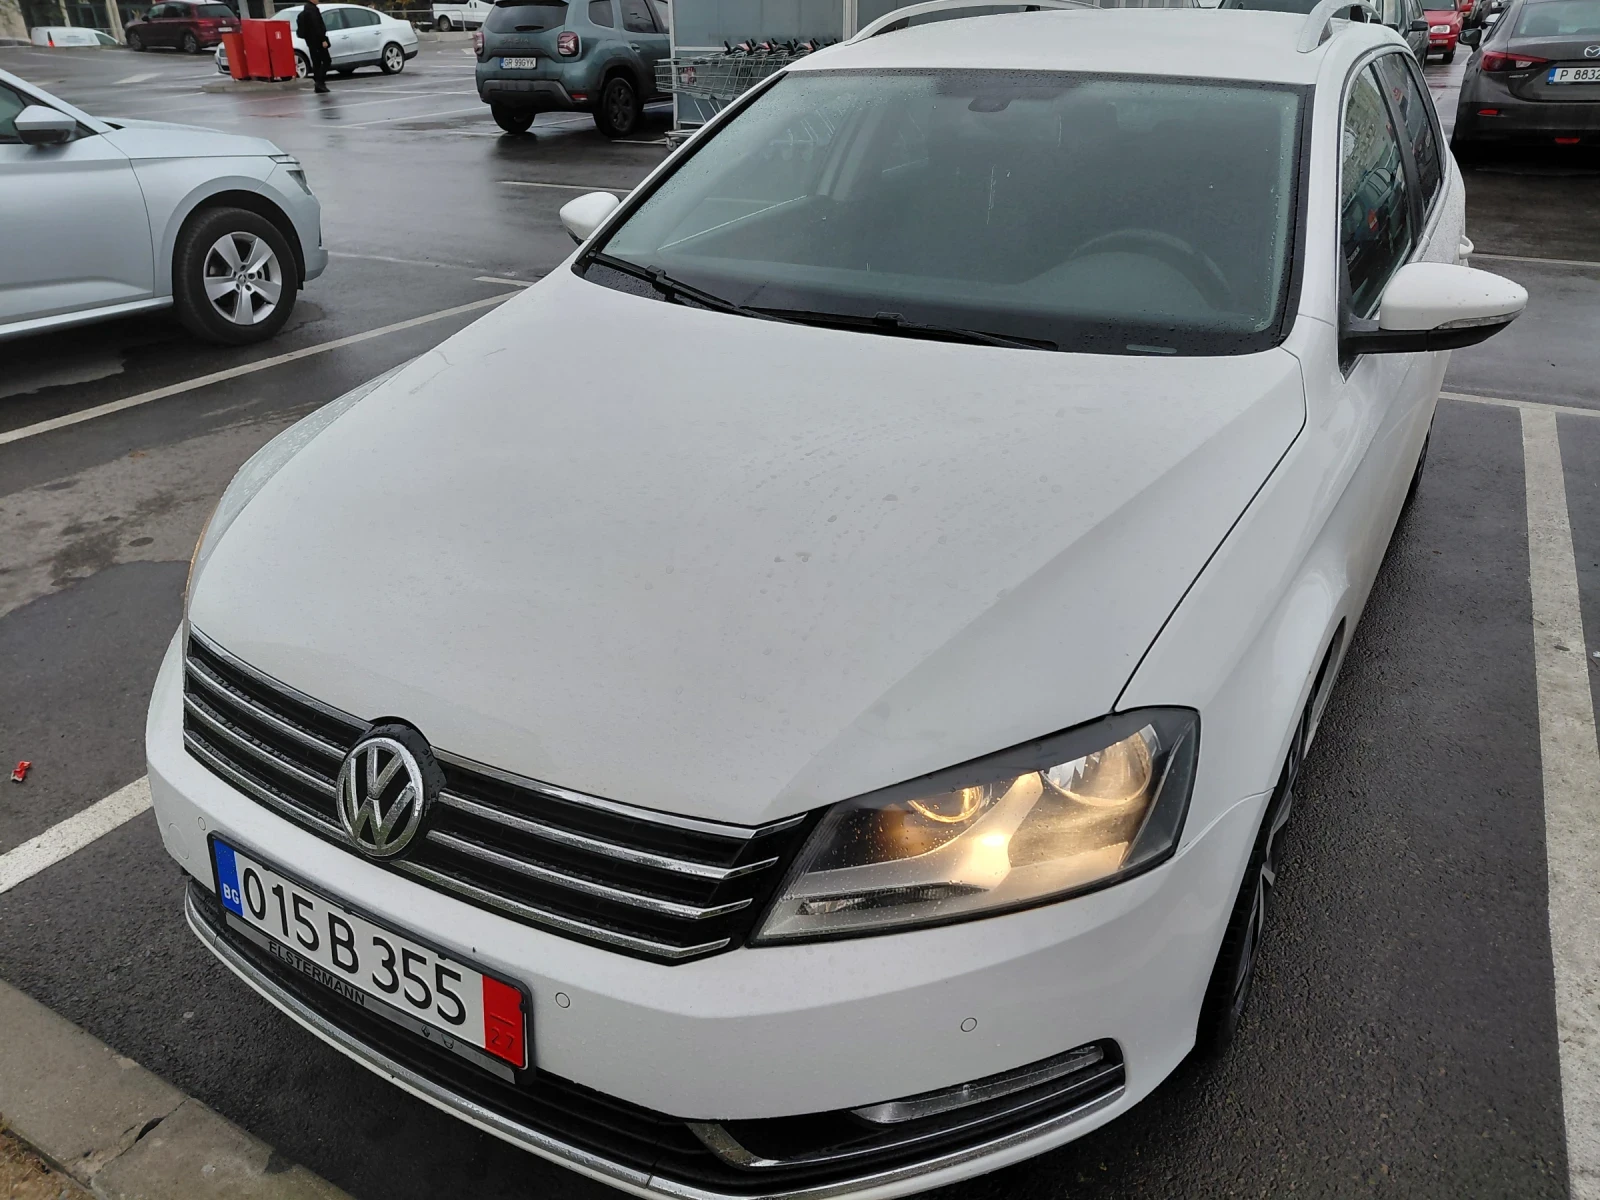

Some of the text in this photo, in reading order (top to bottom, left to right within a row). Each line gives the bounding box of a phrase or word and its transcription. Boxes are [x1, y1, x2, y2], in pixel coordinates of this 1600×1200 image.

[504, 58, 513, 67] GR
[1559, 69, 1569, 80] P
[337, 738, 423, 856] VW
[222, 883, 240, 905] BG
[268, 940, 365, 1006] ELSTERMANN
